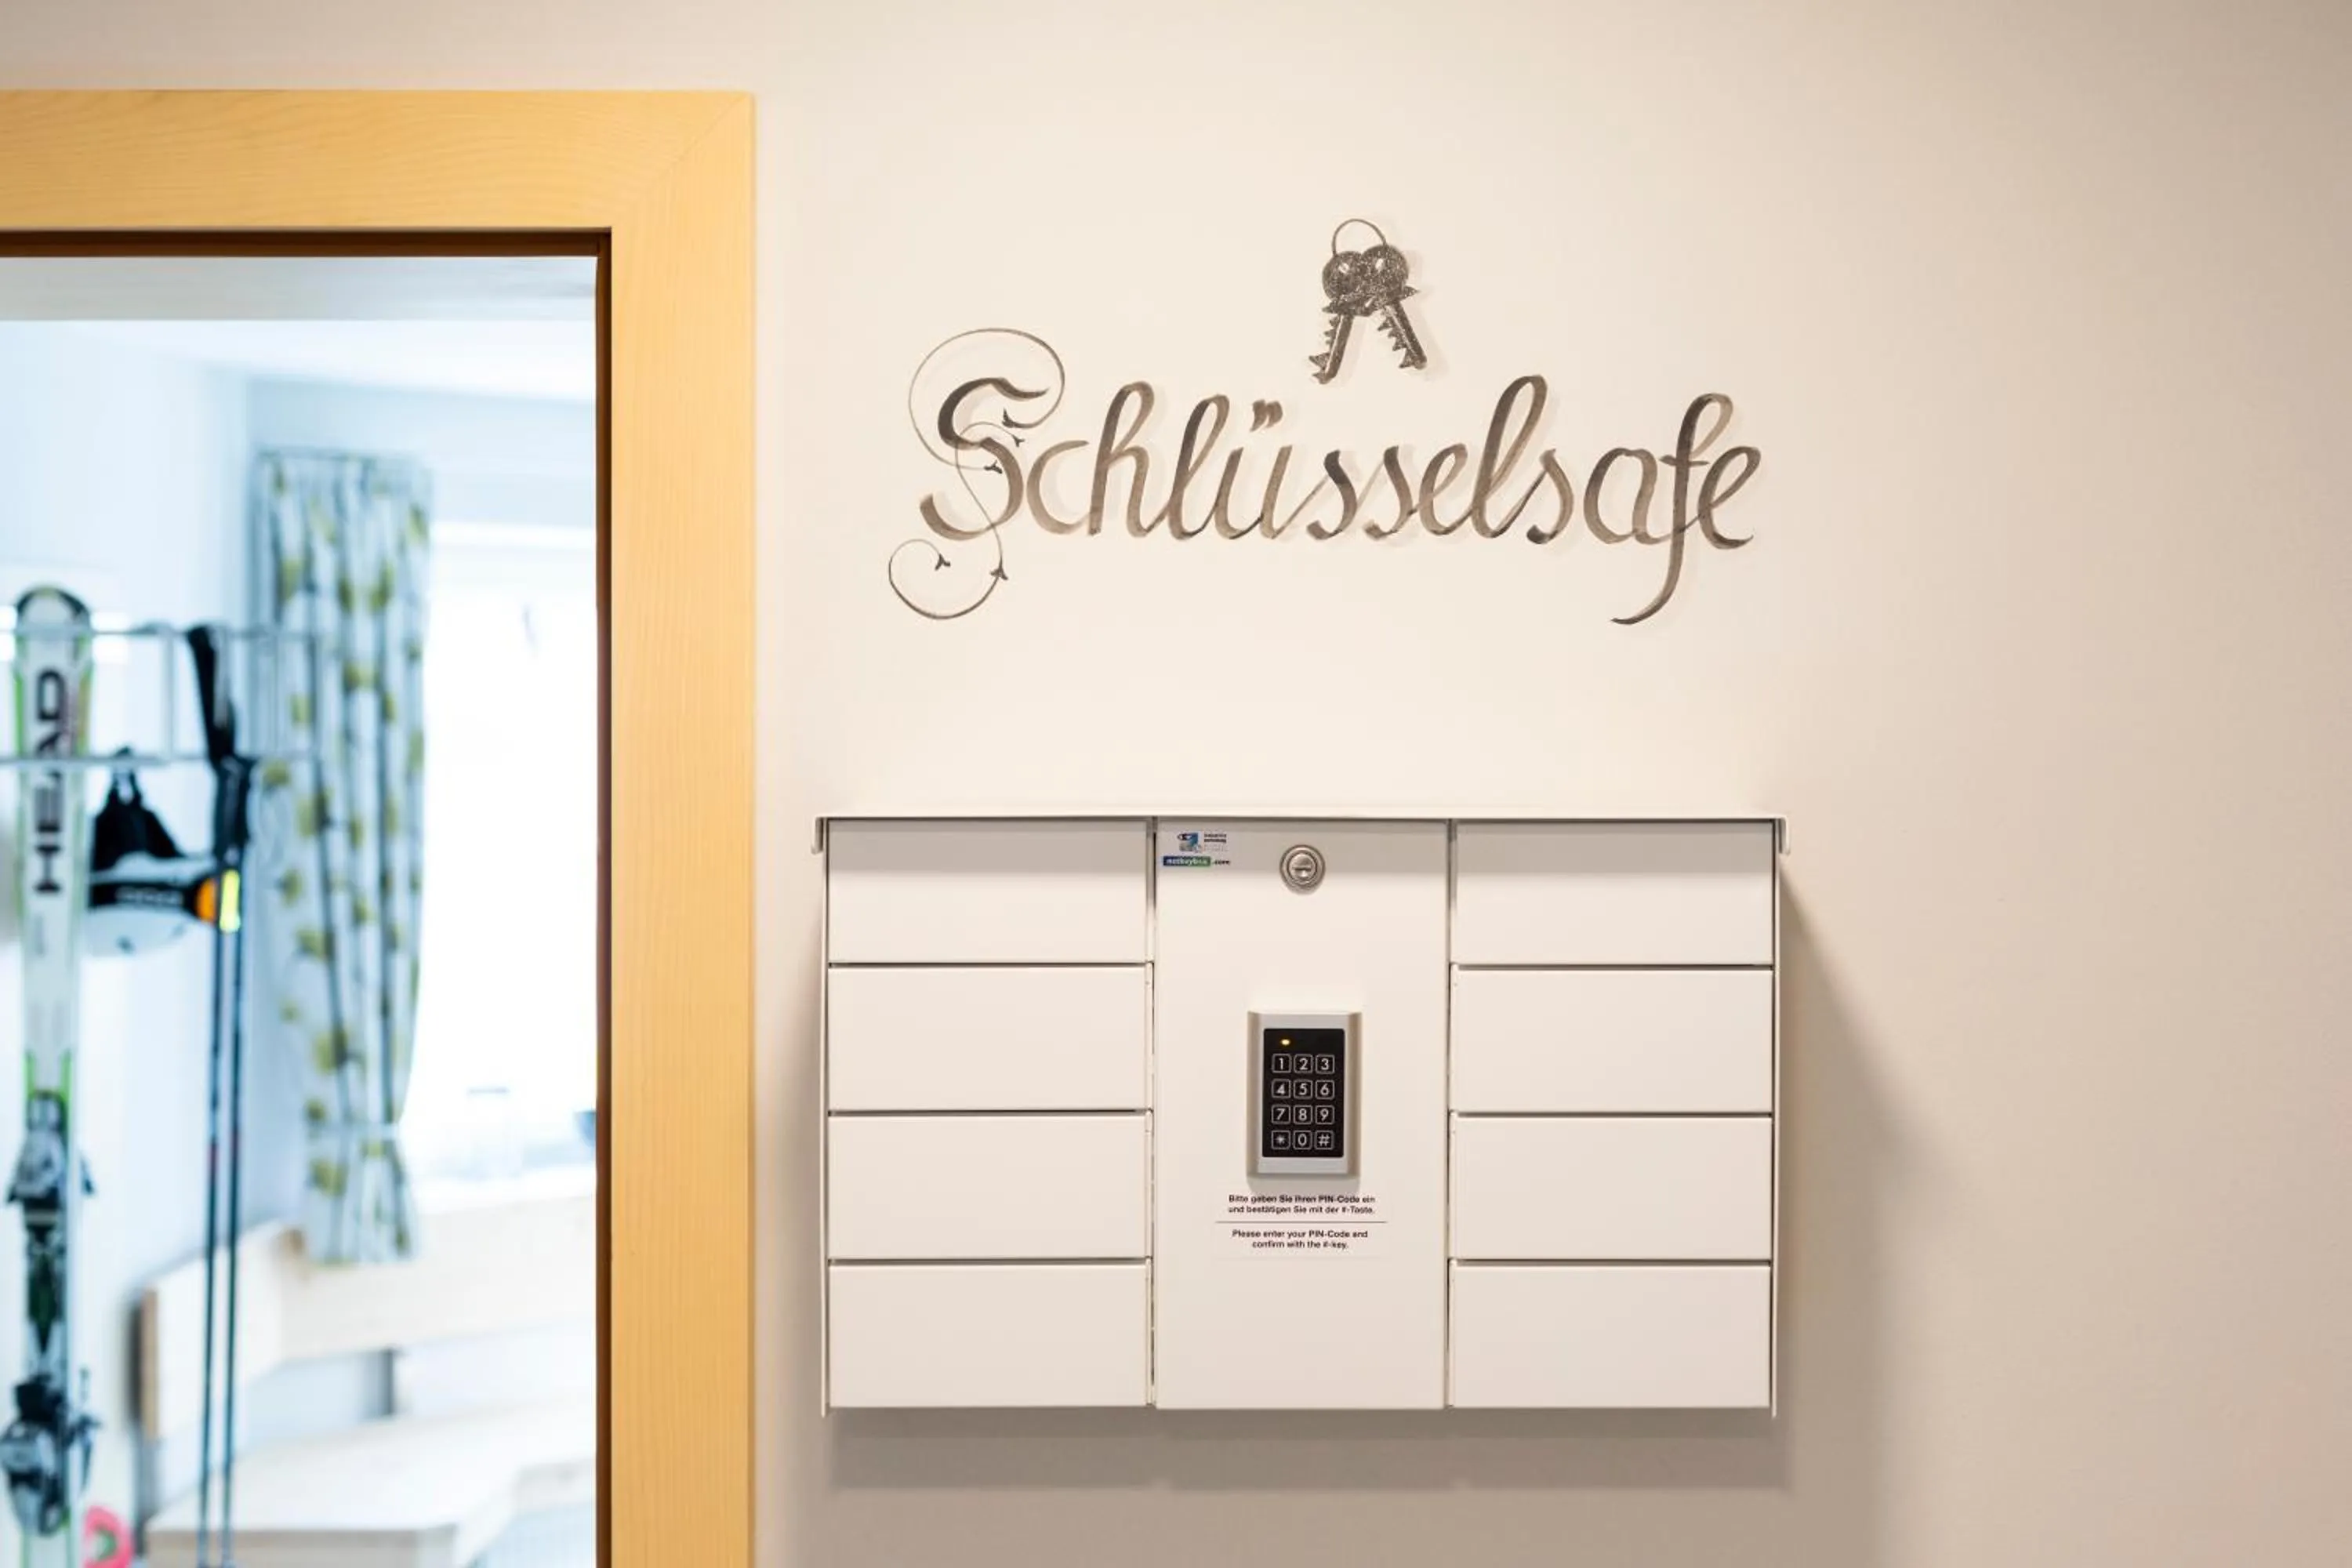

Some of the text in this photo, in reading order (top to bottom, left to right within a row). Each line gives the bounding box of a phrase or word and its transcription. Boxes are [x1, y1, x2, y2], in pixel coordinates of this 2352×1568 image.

[889, 328, 1762, 625] Schlüsselsafe
[34, 670, 64, 894] HEAD
[1279, 1058, 1330, 1070] 1 2 3
[1276, 1083, 1330, 1096] 4 5 6
[1276, 1109, 1329, 1121] 7 8 9
[1298, 1134, 1330, 1146] 0 #
[1229, 1194, 1248, 1203] Bitte
[1250, 1196, 1277, 1204] geben
[1279, 1194, 1293, 1203] Sie
[1294, 1194, 1316, 1203] Ihren
[1318, 1194, 1359, 1203] PIN-Code
[1229, 1205, 1244, 1214] und
[1246, 1205, 1291, 1215] bestätigen
[1293, 1205, 1307, 1214] Sie
[1308, 1205, 1323, 1214] mit
[1324, 1205, 1339, 1214] der
[1232, 1229, 1261, 1238] Please
[1308, 1229, 1350, 1238] PIN-Code
[1352, 1229, 1368, 1238] and
[1252, 1240, 1284, 1248] confirm
[1287, 1240, 1305, 1248] with
[1307, 1240, 1321, 1248] the
